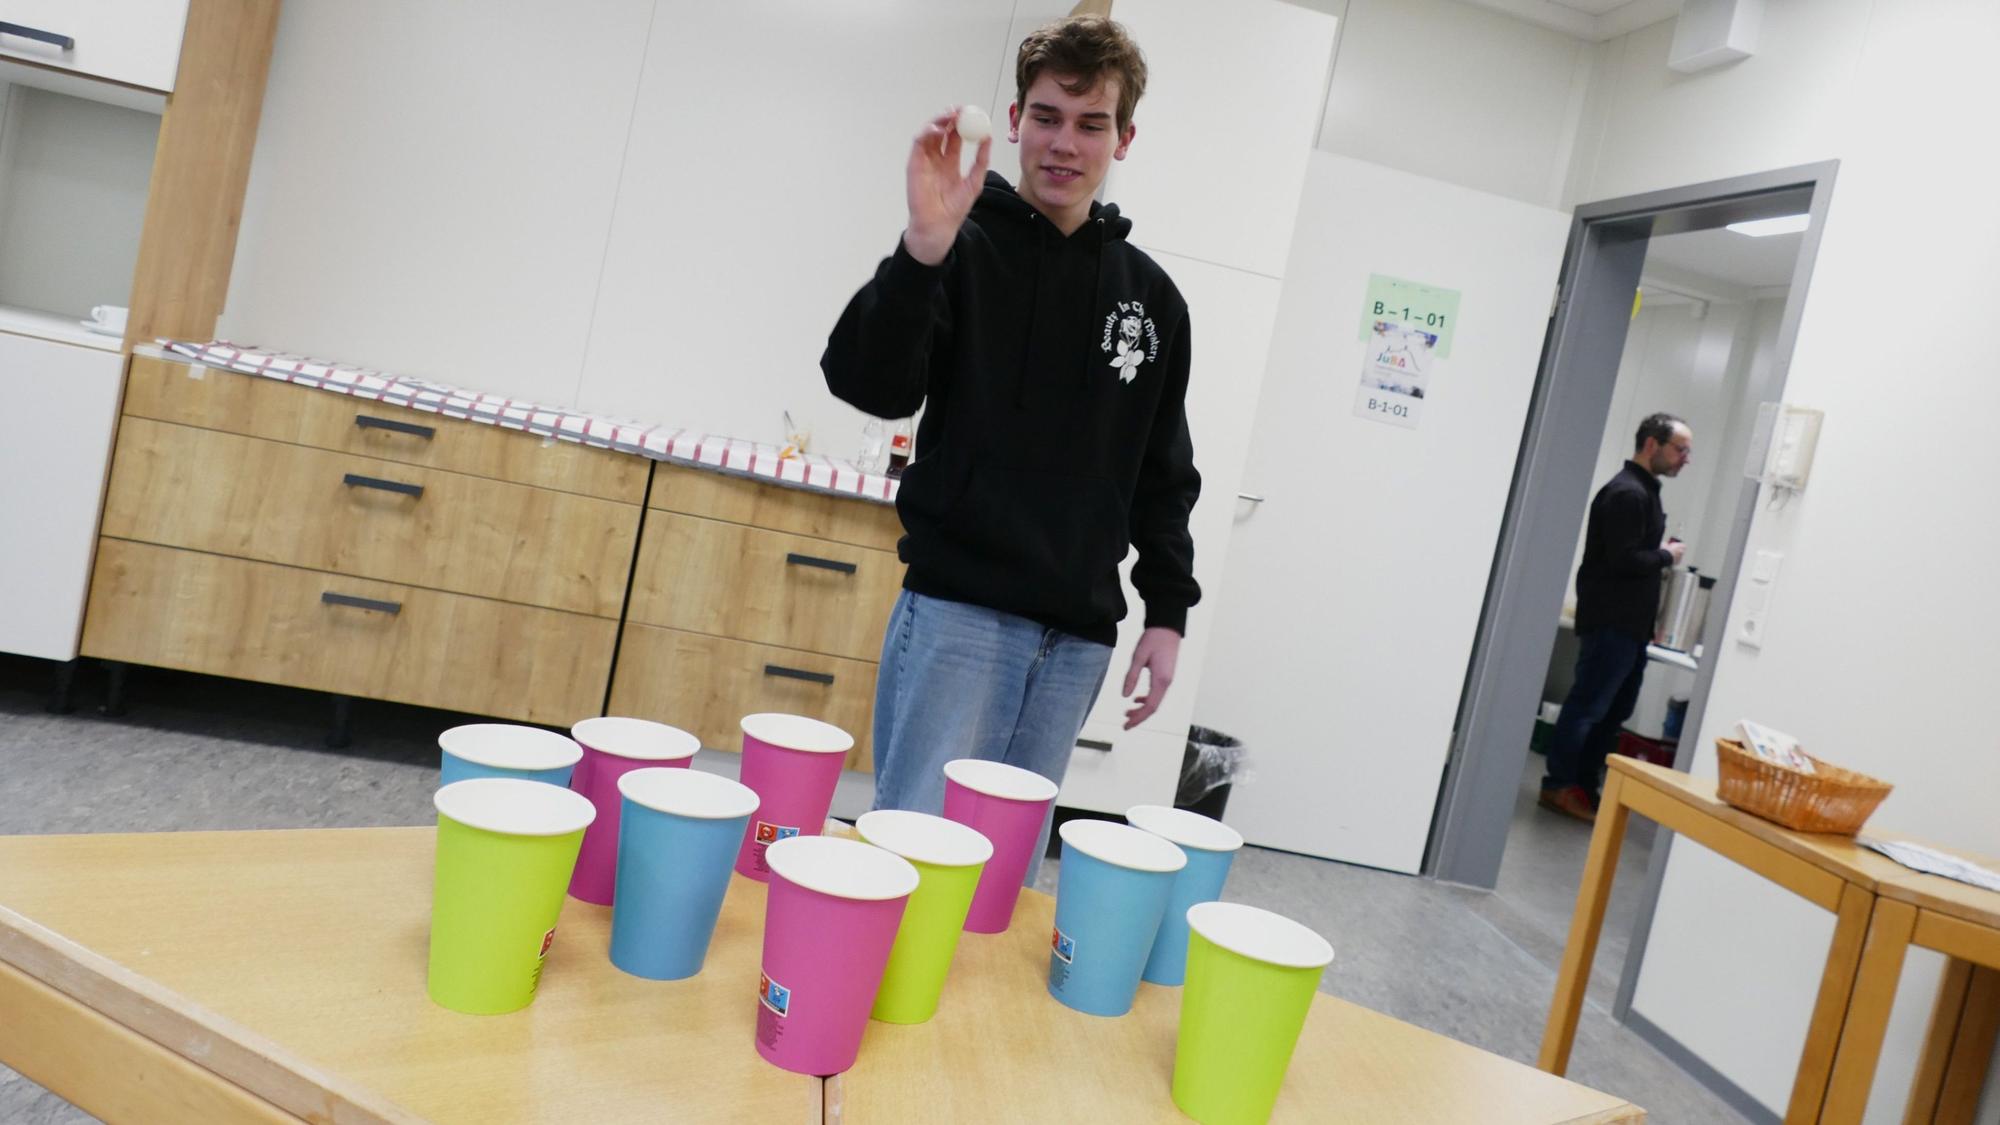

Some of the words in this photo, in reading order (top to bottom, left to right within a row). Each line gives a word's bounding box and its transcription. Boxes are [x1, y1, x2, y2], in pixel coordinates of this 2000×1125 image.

[1101, 311, 1118, 352] Beauty
[1118, 301, 1130, 313] In
[1368, 398, 1409, 418] B-1-01
